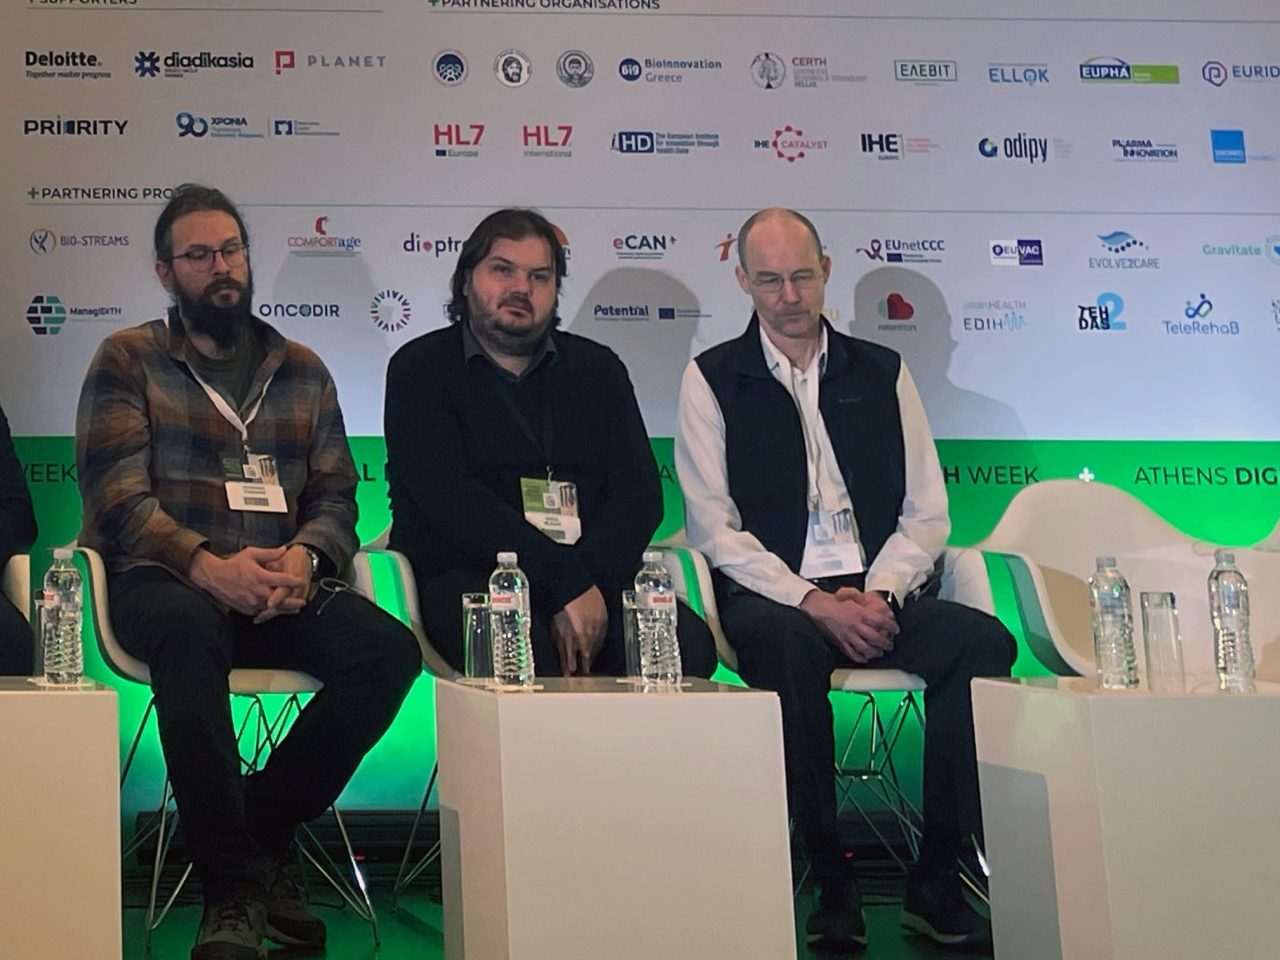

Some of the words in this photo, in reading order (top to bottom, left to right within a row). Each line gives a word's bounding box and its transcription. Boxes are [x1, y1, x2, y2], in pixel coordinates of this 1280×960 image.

[25, 50, 103, 67] Deloitte.
[307, 55, 387, 67] PLANET
[645, 58, 722, 70] BioInnovation
[792, 56, 827, 67] CERTH
[1082, 64, 1130, 79] EUPHA
[645, 73, 683, 83] Greece
[434, 124, 485, 145] HL7
[522, 125, 573, 146] HL7
[754, 140, 770, 149] IHE
[781, 140, 828, 149] CATALYST
[861, 133, 899, 153] IHE
[1004, 132, 1048, 164] odipy
[448, 149, 478, 158] Europe
[524, 150, 572, 158] International
[41, 187, 139, 200] PARTNERING
[143, 187, 174, 200] PRO
[60, 235, 129, 246] BIO-STREAMS
[288, 236, 361, 251] COMFORTage
[885, 239, 945, 251] EUnetCCC
[1202, 244, 1262, 256] Gravitate
[1089, 258, 1160, 269] EVOLVE2CARE
[594, 305, 649, 317] Potential
[877, 323, 917, 332] retention
[963, 317, 1003, 331] EDIH
[1162, 320, 1240, 335] TeleRehaB
[967, 466, 1040, 484] WEEK
[1134, 466, 1228, 486] ATHENS
